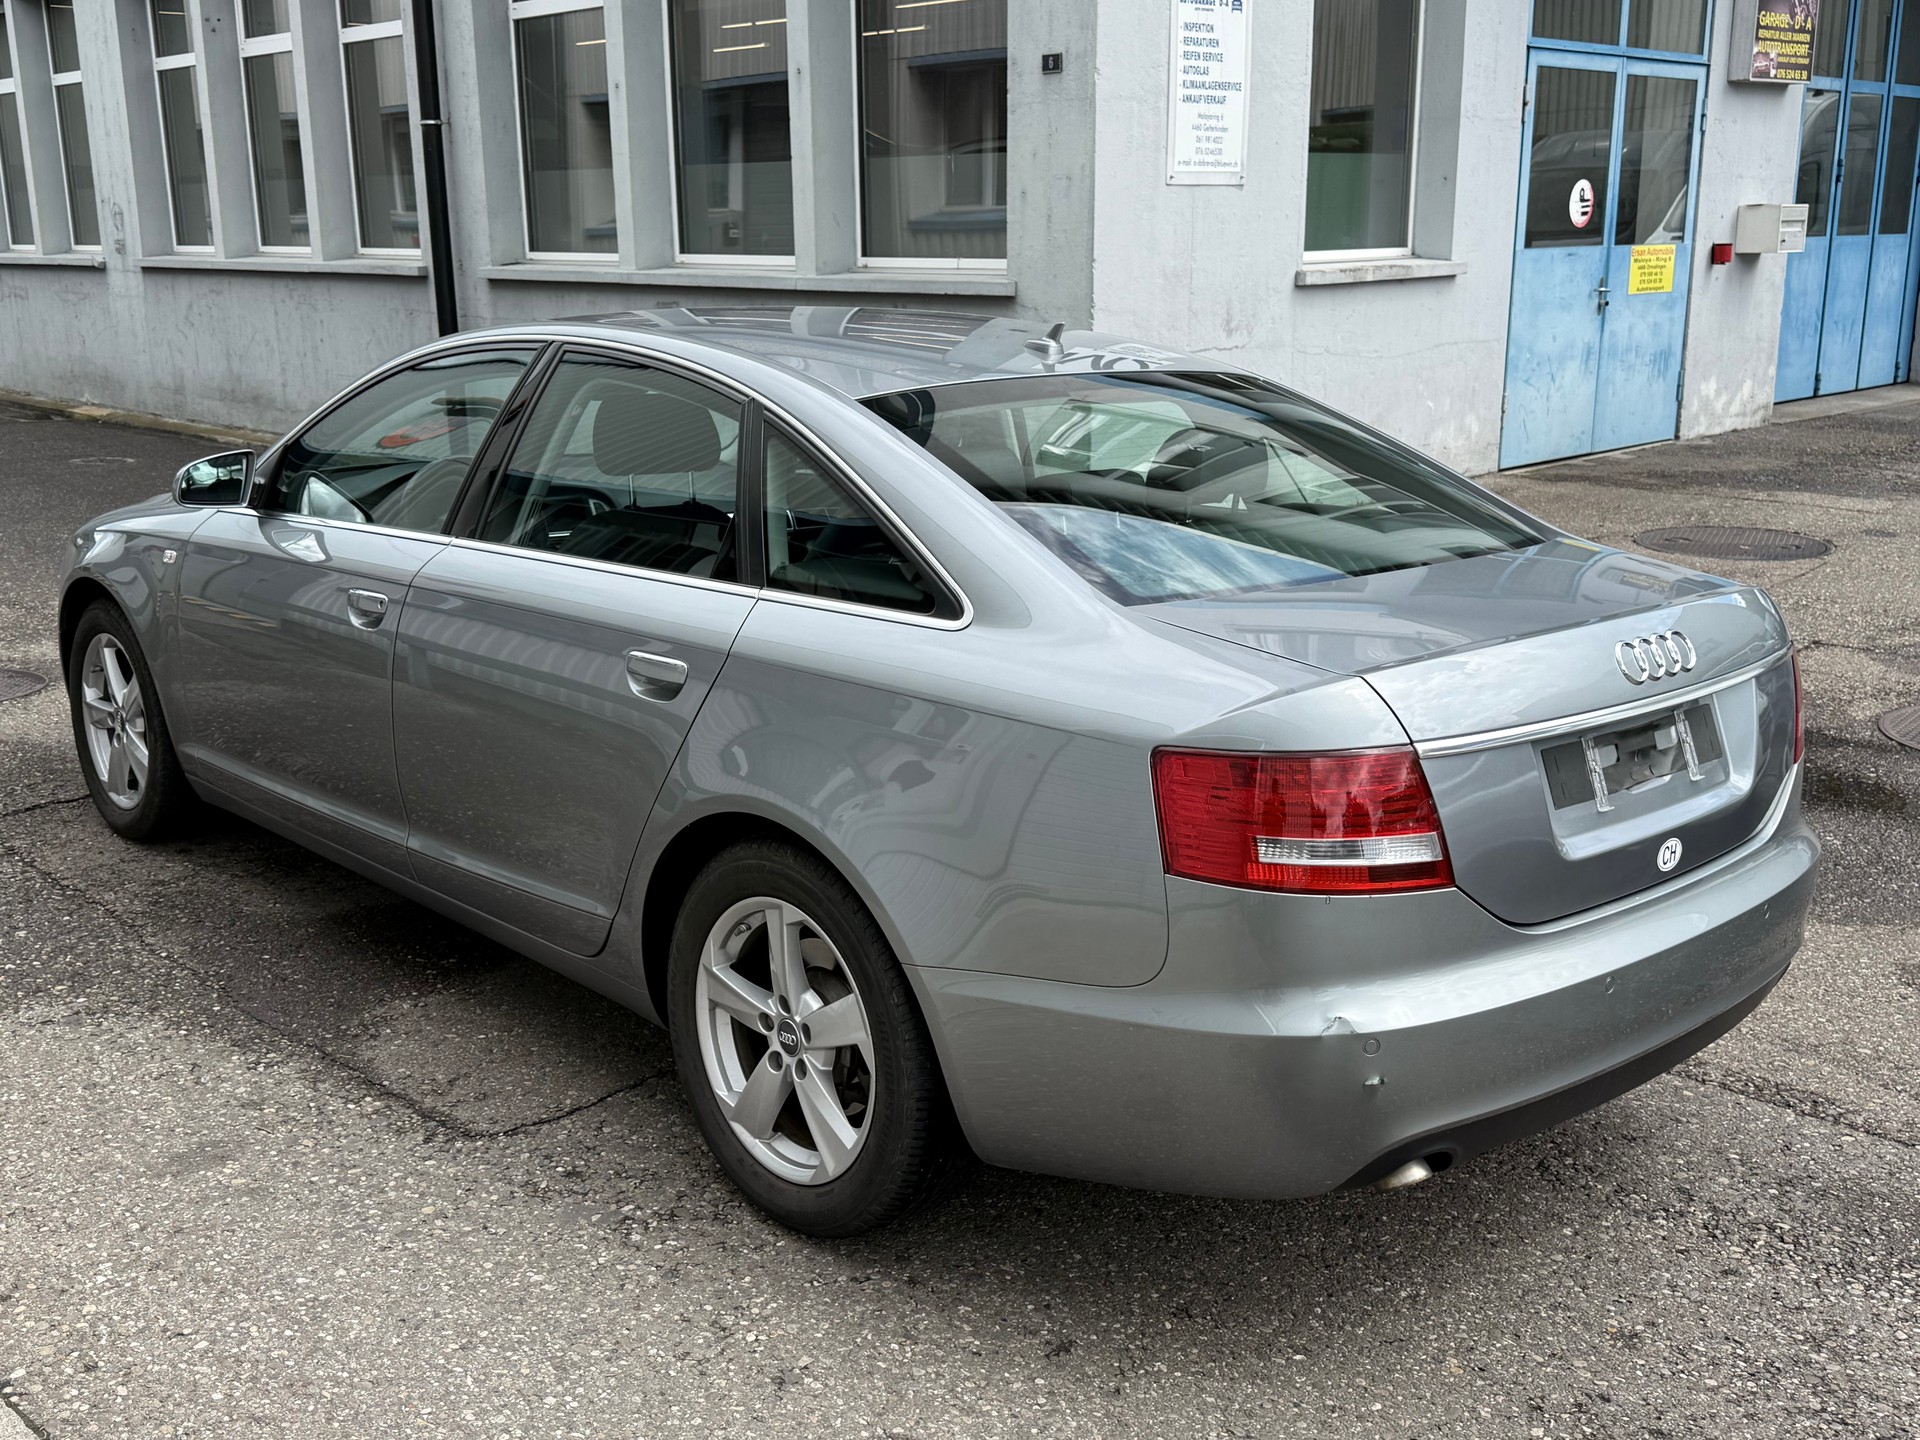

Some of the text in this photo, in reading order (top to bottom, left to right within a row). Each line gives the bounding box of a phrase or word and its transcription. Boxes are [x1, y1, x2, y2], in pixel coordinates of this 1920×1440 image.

[1759, 10, 1789, 28] GARAGE
[1183, 21, 1214, 33] INSPEKTION
[1183, 36, 1220, 48] REPARATUREN
[1780, 31, 1792, 41] ALLER
[1793, 32, 1811, 43] MARKEN
[1758, 40, 1809, 56] AUTOTRANSPORT
[1183, 50, 1224, 62] REIFEN SERVICE
[1048, 56, 1054, 69] 6
[1183, 65, 1209, 76] AUTOGLAS
[1182, 79, 1242, 92] KLIMAANLAGENSERVICE
[1632, 246, 1675, 257] Ersan Automobile
[1662, 842, 1678, 866] CH
